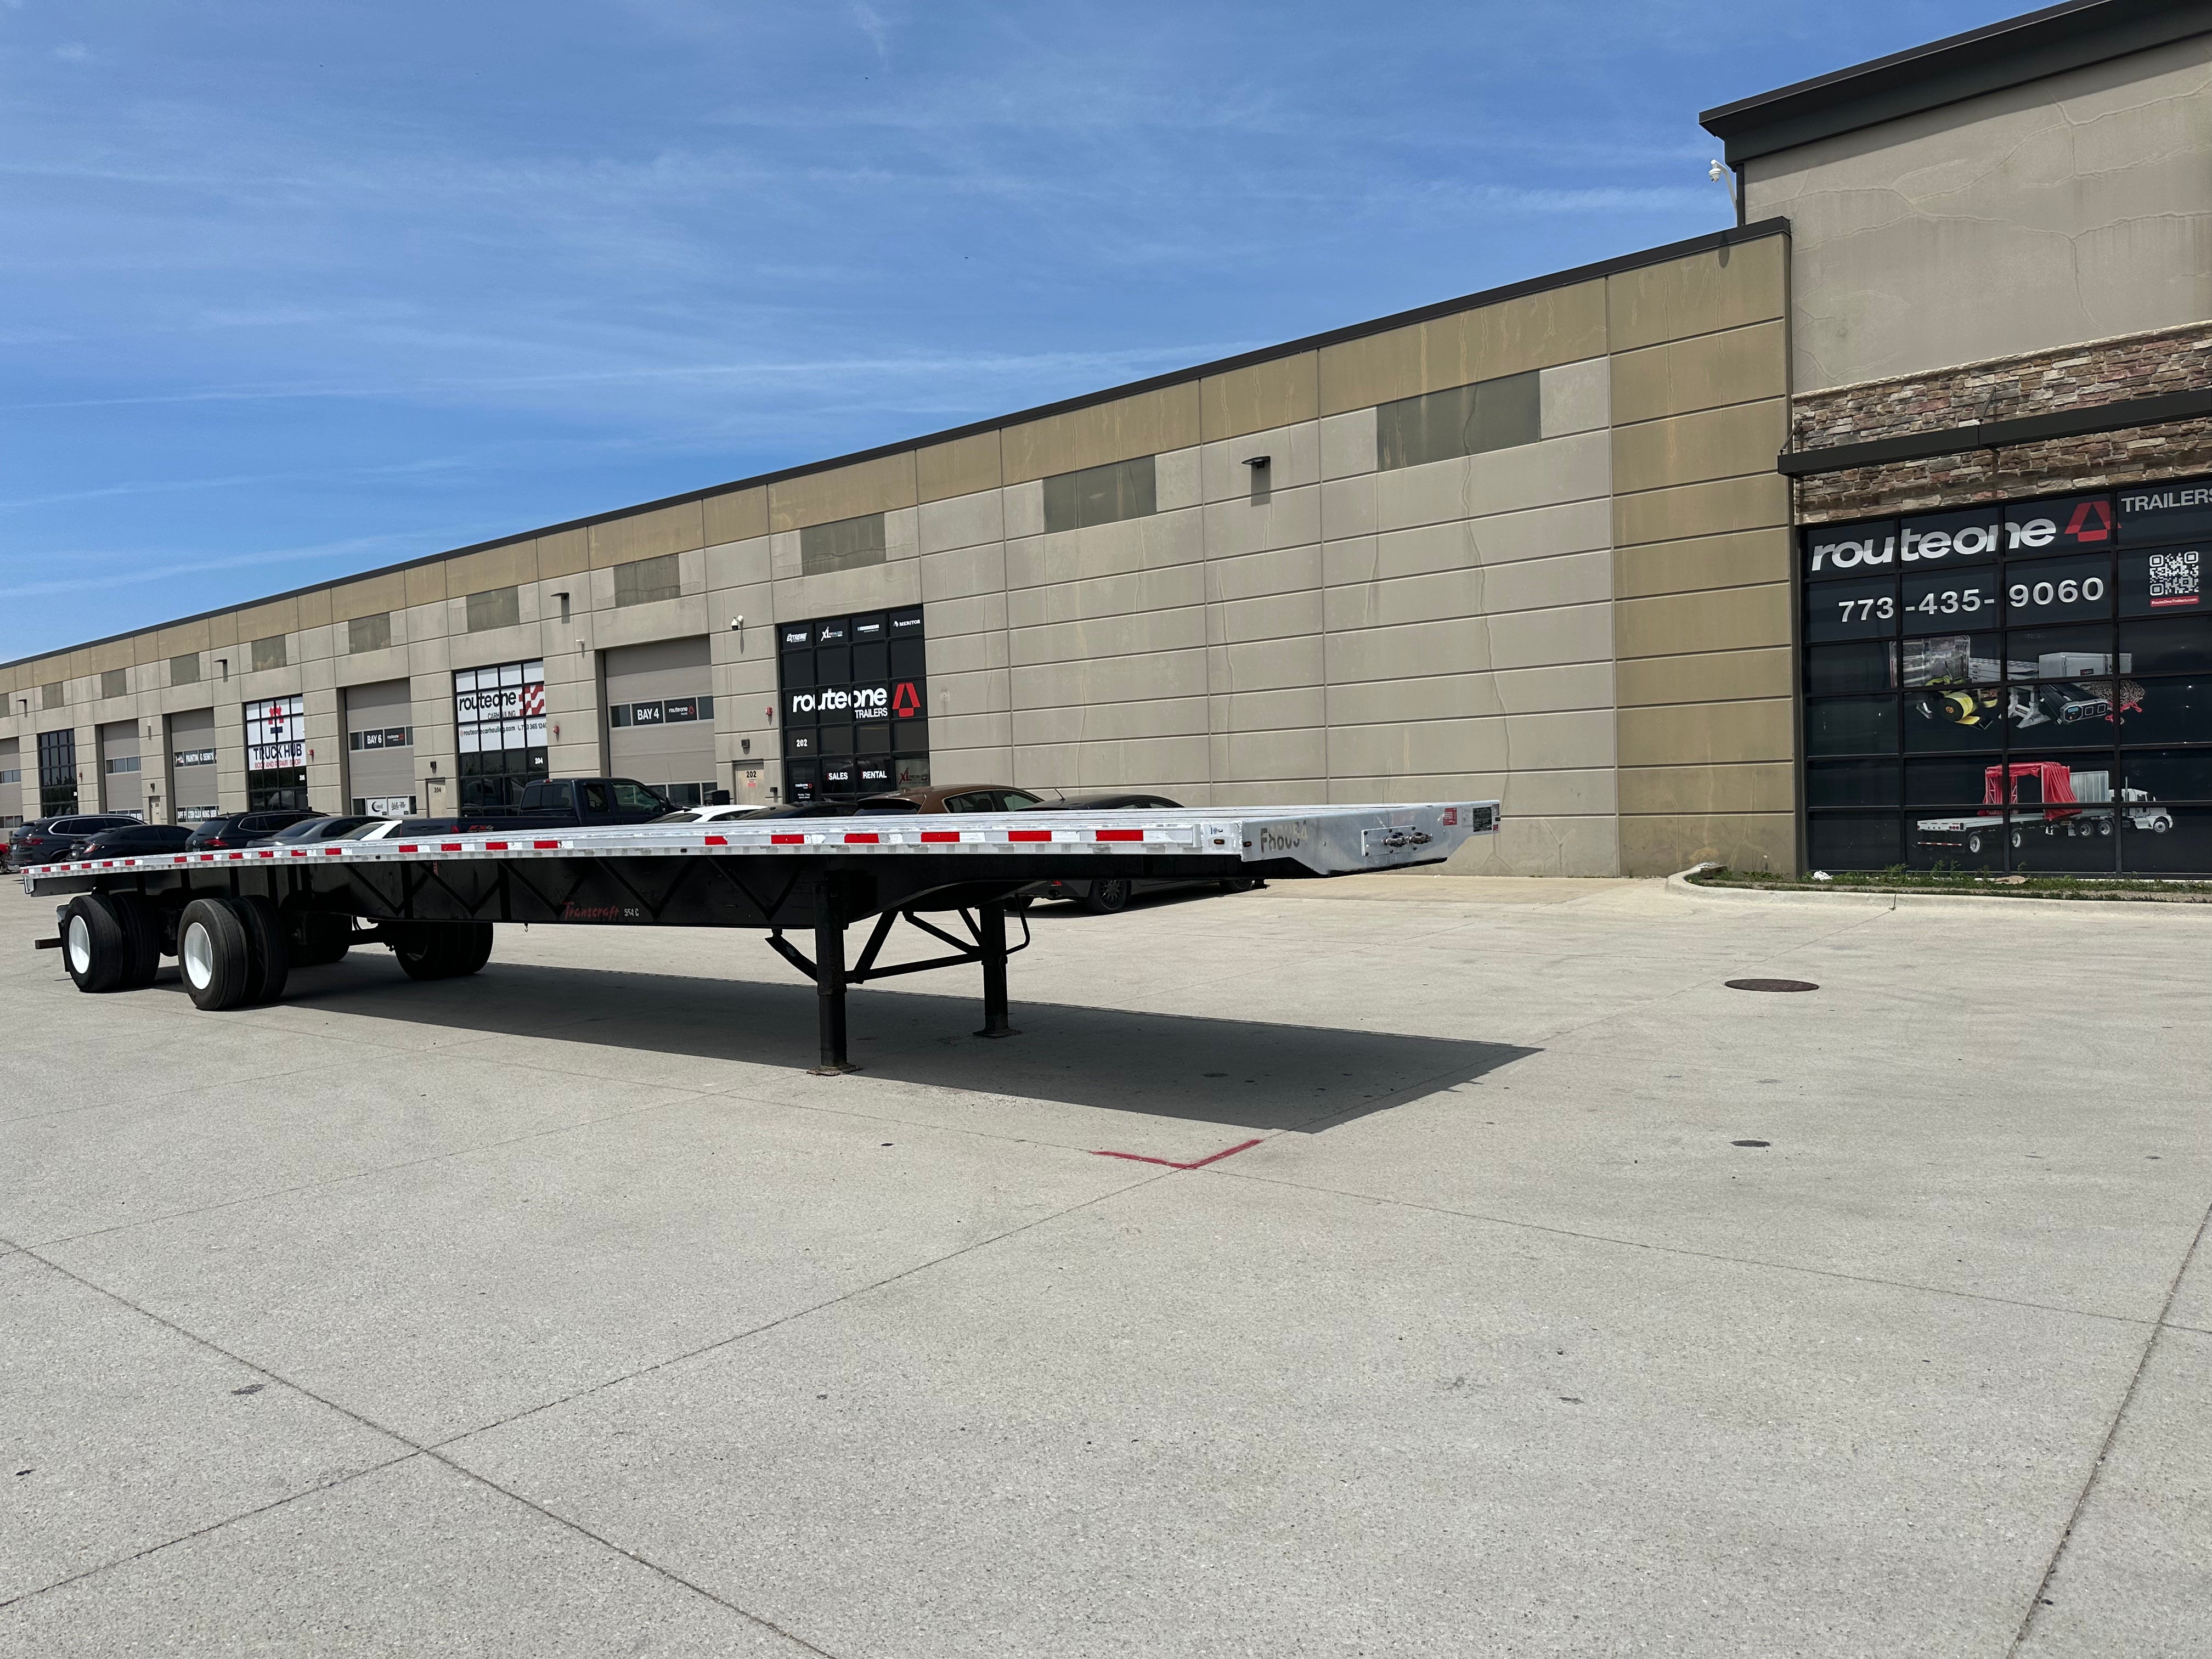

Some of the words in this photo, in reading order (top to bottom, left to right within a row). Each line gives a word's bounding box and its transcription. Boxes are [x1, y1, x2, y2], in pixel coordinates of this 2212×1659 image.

[2121, 488, 2212, 512] TRAILER
[1812, 518, 2056, 571] routeone
[1838, 596, 1894, 622] 773
[2009, 577, 2104, 607] 9060
[786, 633, 807, 643] EXTREME
[821, 626, 832, 641] XL
[460, 692, 516, 712] routeone
[793, 687, 888, 713] routeone
[637, 708, 653, 720] BAY
[653, 708, 659, 719] 4
[854, 707, 888, 719] TRAILERS
[367, 735, 377, 744] BAY
[377, 734, 382, 744] 6
[796, 738, 808, 747] 202
[253, 745, 283, 760] TRUCK
[284, 743, 302, 758] HUB
[828, 772, 848, 781] SALES
[862, 770, 887, 779] RENTAL
[899, 768, 912, 785] XL
[562, 901, 619, 921] Transcraft
[624, 909, 634, 917] 554
[635, 908, 639, 917] C
